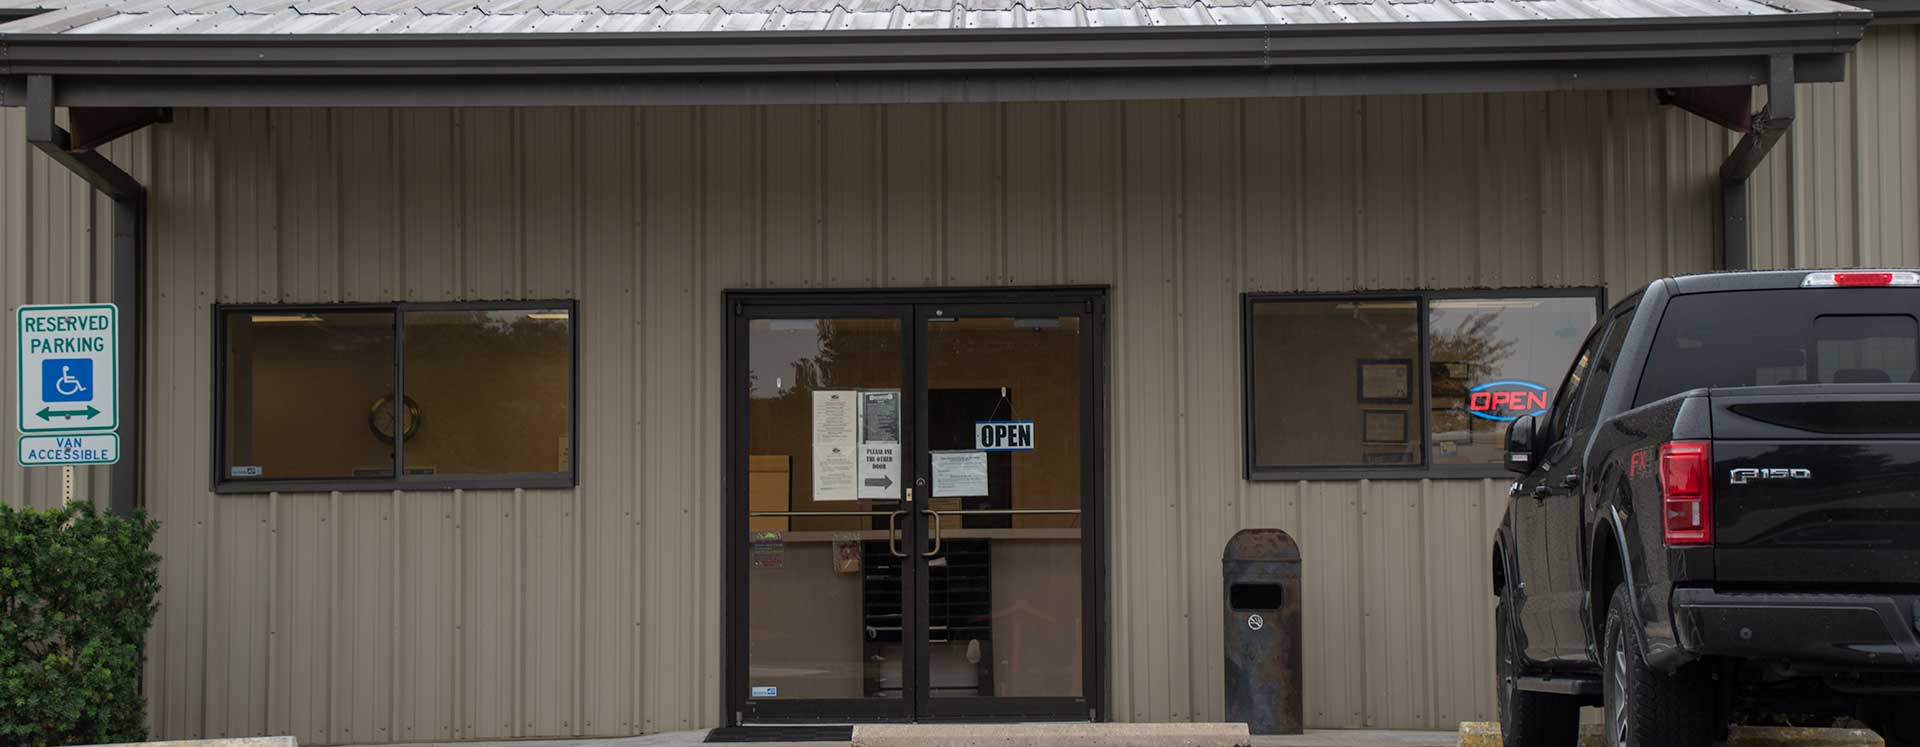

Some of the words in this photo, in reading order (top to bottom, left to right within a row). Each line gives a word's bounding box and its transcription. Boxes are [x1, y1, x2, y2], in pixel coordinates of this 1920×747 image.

[25, 315, 109, 333] RESERVED
[31, 337, 104, 353] PARKING
[1470, 391, 1547, 411] OPEN
[56, 438, 82, 448] VAN
[981, 424, 1031, 448] OPEN
[28, 449, 109, 461] ACCESSIBLE
